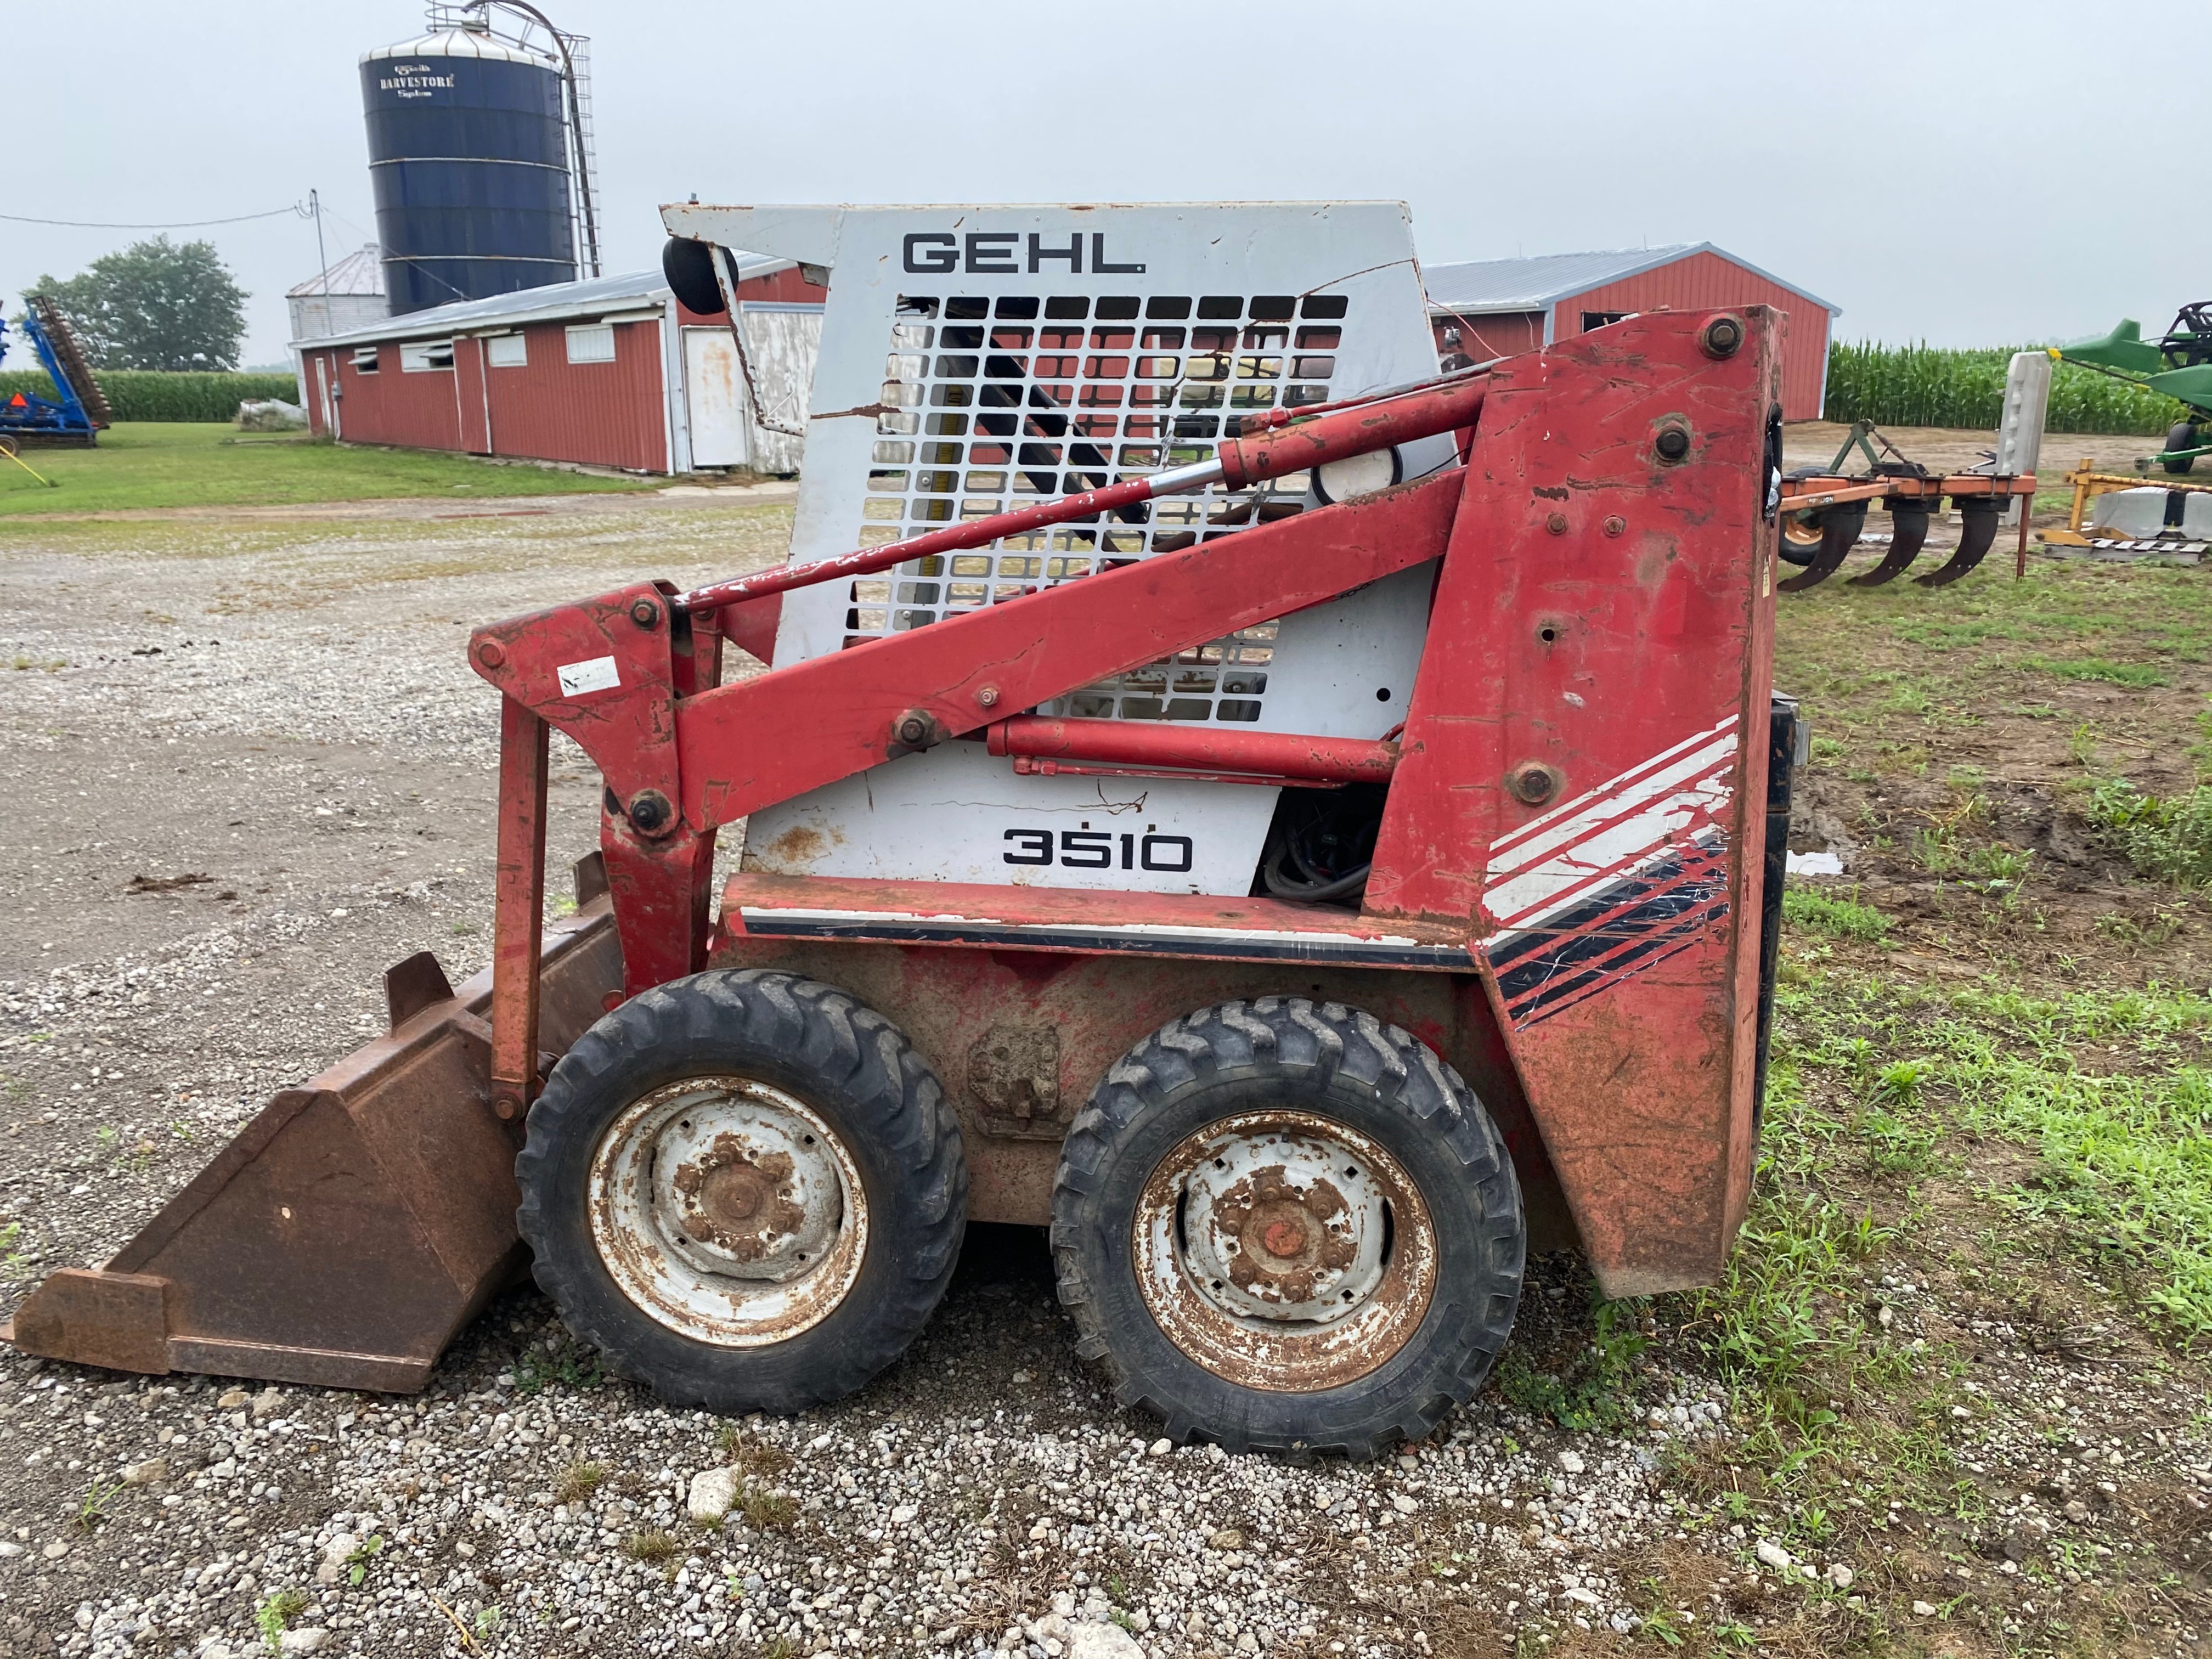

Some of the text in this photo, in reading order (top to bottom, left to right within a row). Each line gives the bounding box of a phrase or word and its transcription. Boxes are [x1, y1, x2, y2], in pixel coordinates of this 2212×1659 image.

[380, 76, 454, 89] HARVESTORE
[904, 233, 1146, 273] GEHL
[1003, 829, 1192, 872] 3510
[1370, 1347, 1449, 1412] TITAN
